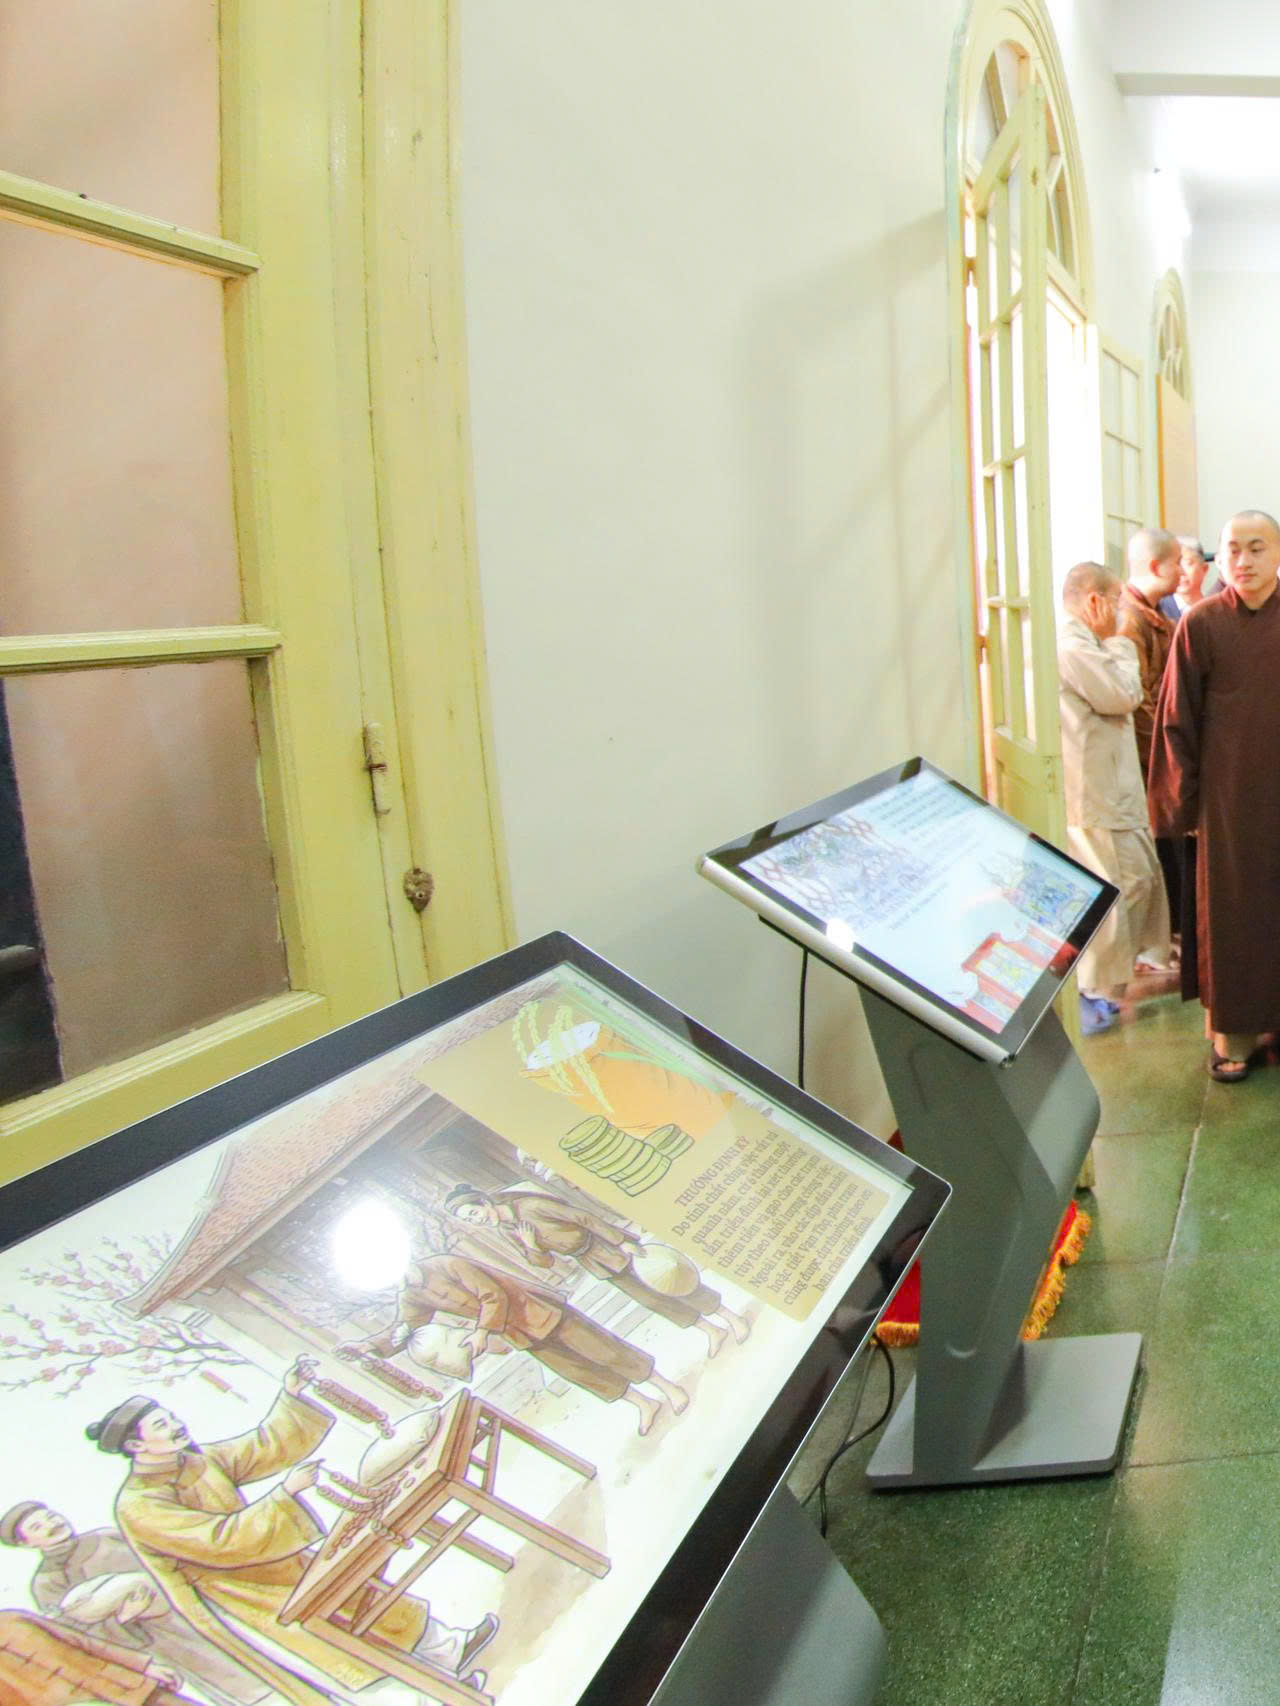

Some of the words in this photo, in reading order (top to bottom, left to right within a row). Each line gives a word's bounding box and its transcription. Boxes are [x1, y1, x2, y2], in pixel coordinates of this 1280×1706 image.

[777, 1184, 793, 1200] cho
[671, 1220, 690, 1236] Do
[690, 1213, 726, 1246] quanh
[747, 1238, 769, 1260] theo
